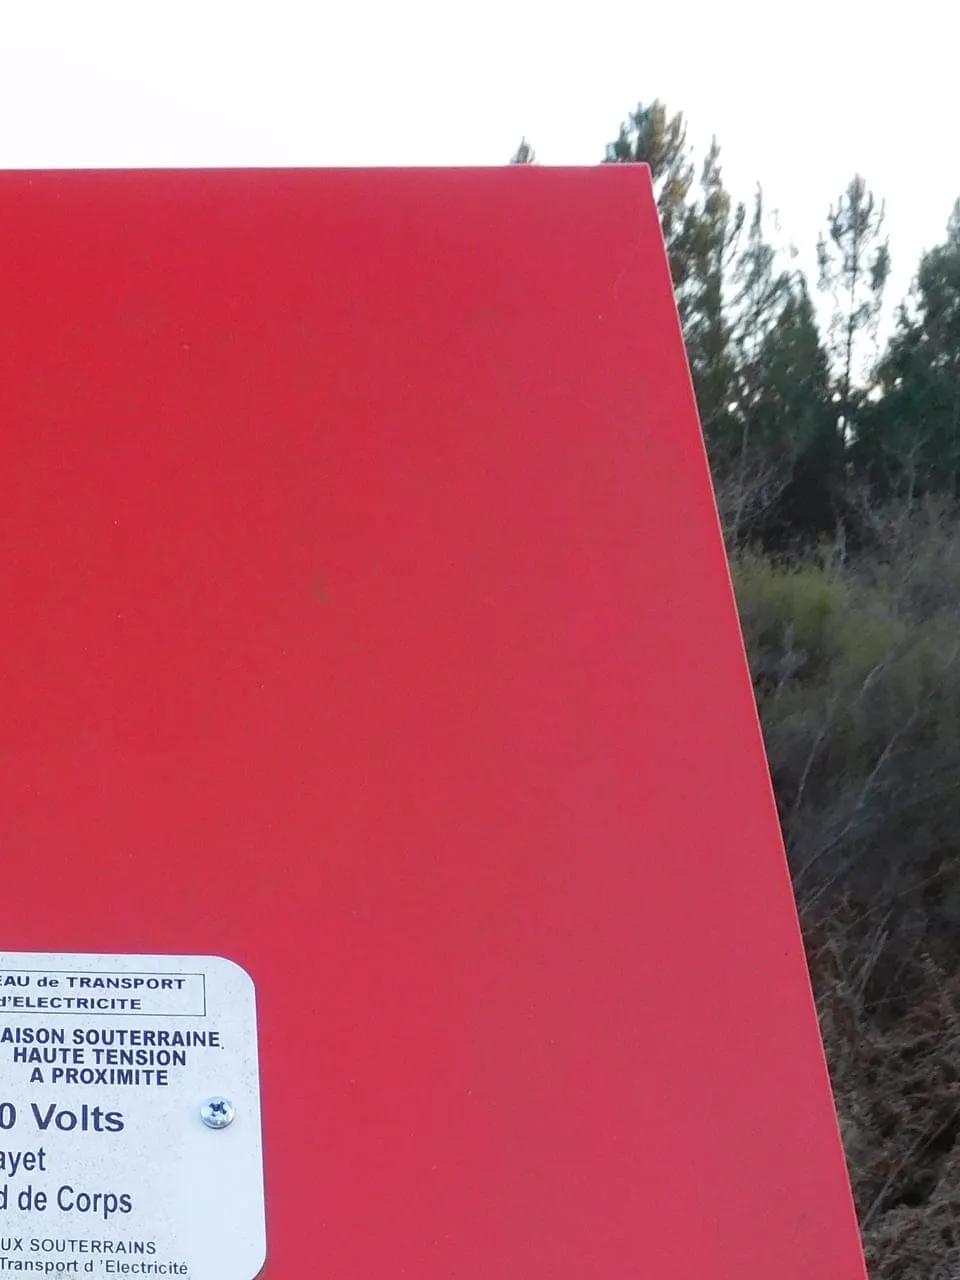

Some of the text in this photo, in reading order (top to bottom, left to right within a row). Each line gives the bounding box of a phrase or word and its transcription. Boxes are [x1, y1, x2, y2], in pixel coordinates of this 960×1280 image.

[37, 977, 59, 987] de
[66, 976, 186, 989] TRANSPORT
[72, 1029, 220, 1047] SOUTERRAINE
[14, 1048, 186, 1066] HAUTE TENSION
[30, 1067, 168, 1085] A PROXIMITE
[31, 1103, 124, 1132] Volts
[18, 1185, 47, 1211] de
[57, 1185, 132, 1219] Corps
[30, 1239, 156, 1254] SOUTERRAINS
